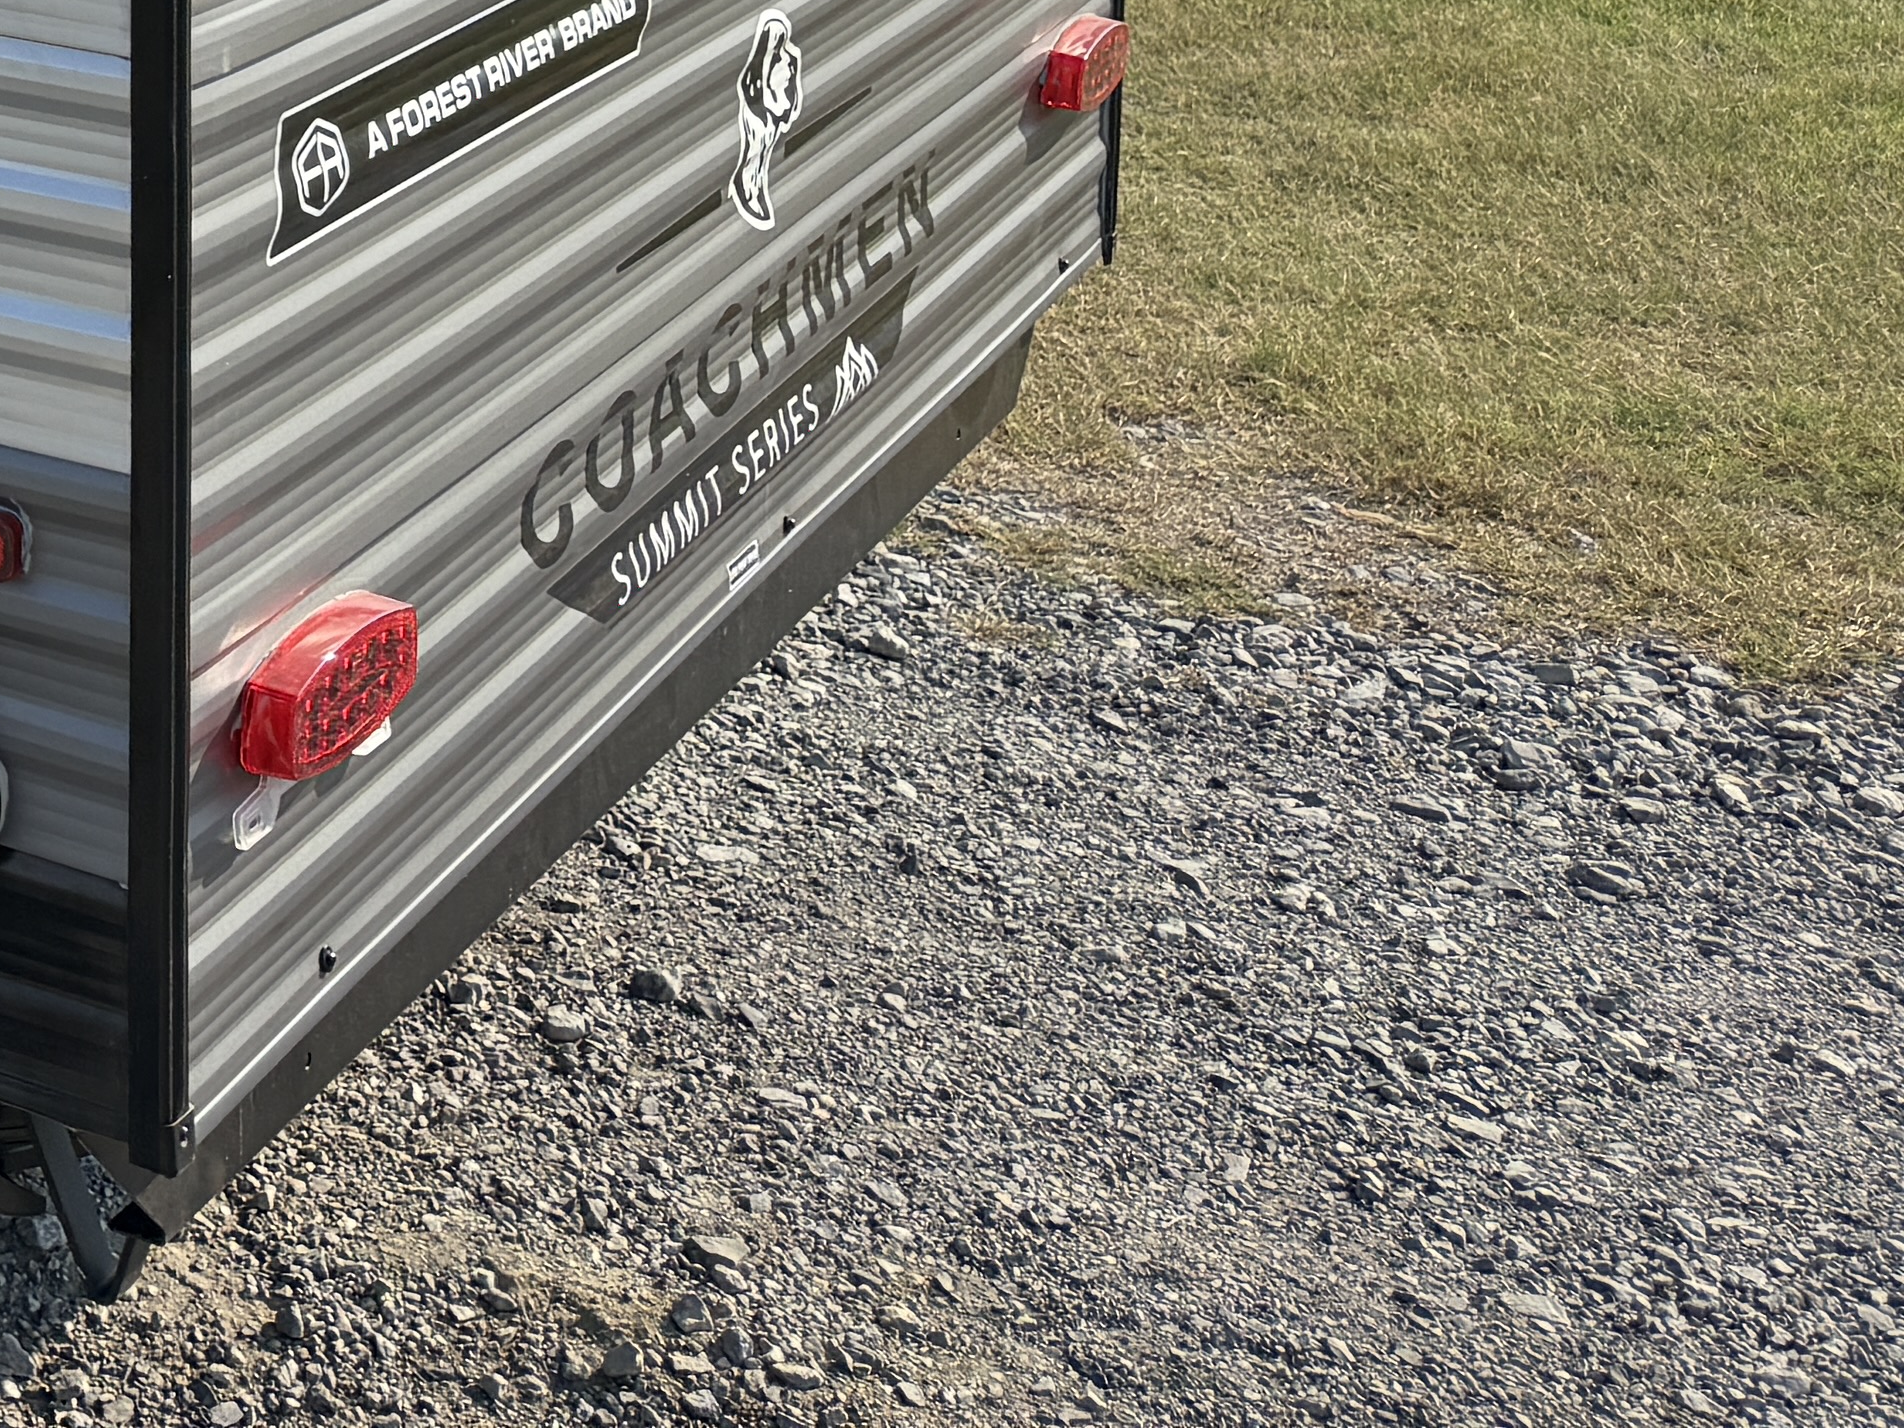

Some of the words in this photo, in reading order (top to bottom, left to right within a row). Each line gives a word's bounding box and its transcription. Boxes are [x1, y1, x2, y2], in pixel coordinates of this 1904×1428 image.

[368, 120, 388, 159] A
[386, 65, 484, 147] FOREST
[520, 148, 936, 569] COACHMEN
[611, 465, 724, 606] SUMMIT
[731, 384, 820, 495] SERIES
